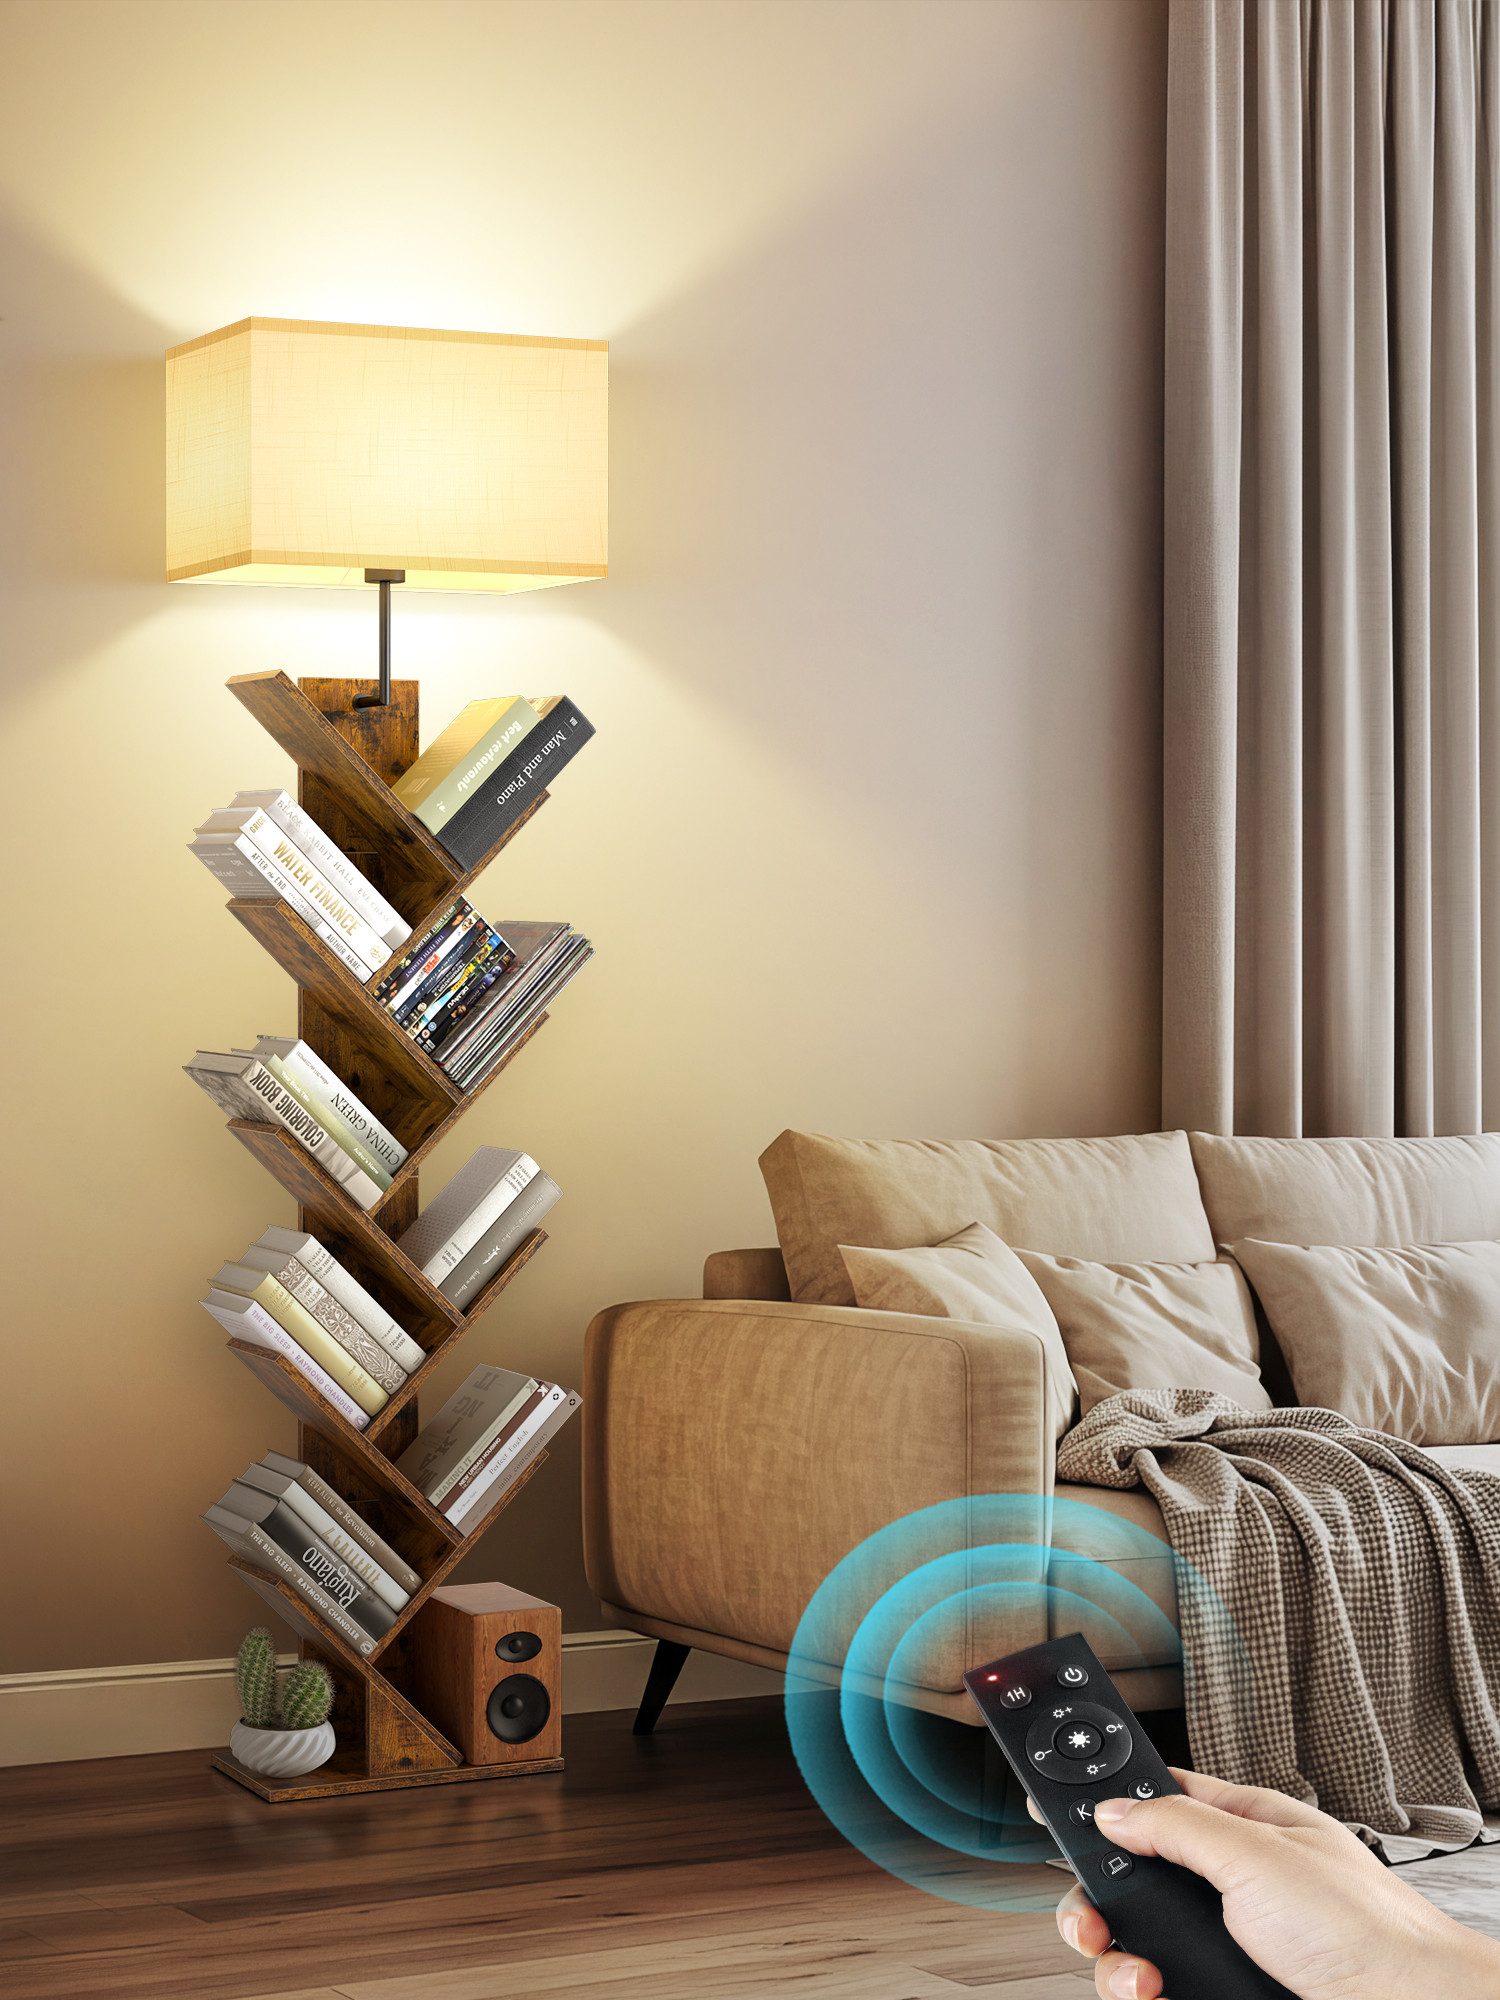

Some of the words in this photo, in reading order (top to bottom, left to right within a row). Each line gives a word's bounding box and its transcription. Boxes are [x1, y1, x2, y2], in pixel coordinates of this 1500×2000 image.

[500, 720, 523, 743] Best
[540, 729, 567, 757] Man
[456, 740, 503, 792] restaurants
[522, 753, 546, 778] and
[497, 773, 527, 805] Piano
[250, 851, 269, 870] AFTER
[273, 876, 287, 890] END
[270, 840, 317, 886] WATER
[307, 880, 363, 936] FINANCE
[326, 933, 347, 956] AUTHOR
[345, 950, 361, 971] NAME
[248, 1068, 283, 1103] BOOK
[273, 1093, 327, 1148] COLORING
[329, 1092, 369, 1132] GREEN
[363, 1127, 402, 1167] CHINA
[250, 1310, 264, 1324] THE
[261, 1321, 274, 1334] BIG
[273, 1332, 291, 1351] SLEEP
[294, 1354, 325, 1385] RAYMOND
[322, 1383, 354, 1415] CHANDLER
[457, 1473, 470, 1486] NEW
[467, 1457, 483, 1475] URBAN
[480, 1437, 502, 1459] HOUSING
[487, 1453, 509, 1475] Perfect
[507, 1428, 529, 1452] English
[434, 1465, 465, 1499] MAKING
[463, 1456, 473, 1466] IT
[306, 1476, 337, 1508] REVEALING
[342, 1512, 377, 1547] Revolution
[249, 1531, 263, 1545] THE
[261, 1543, 275, 1556] BIG
[273, 1554, 293, 1574] SLEEP
[296, 1576, 329, 1609] RAYMOND
[326, 1607, 360, 1640] CHANDLER
[302, 1546, 362, 1610] Rugiano
[1007, 1687, 1027, 1702] 1H
[1076, 1803, 1093, 1820] K
